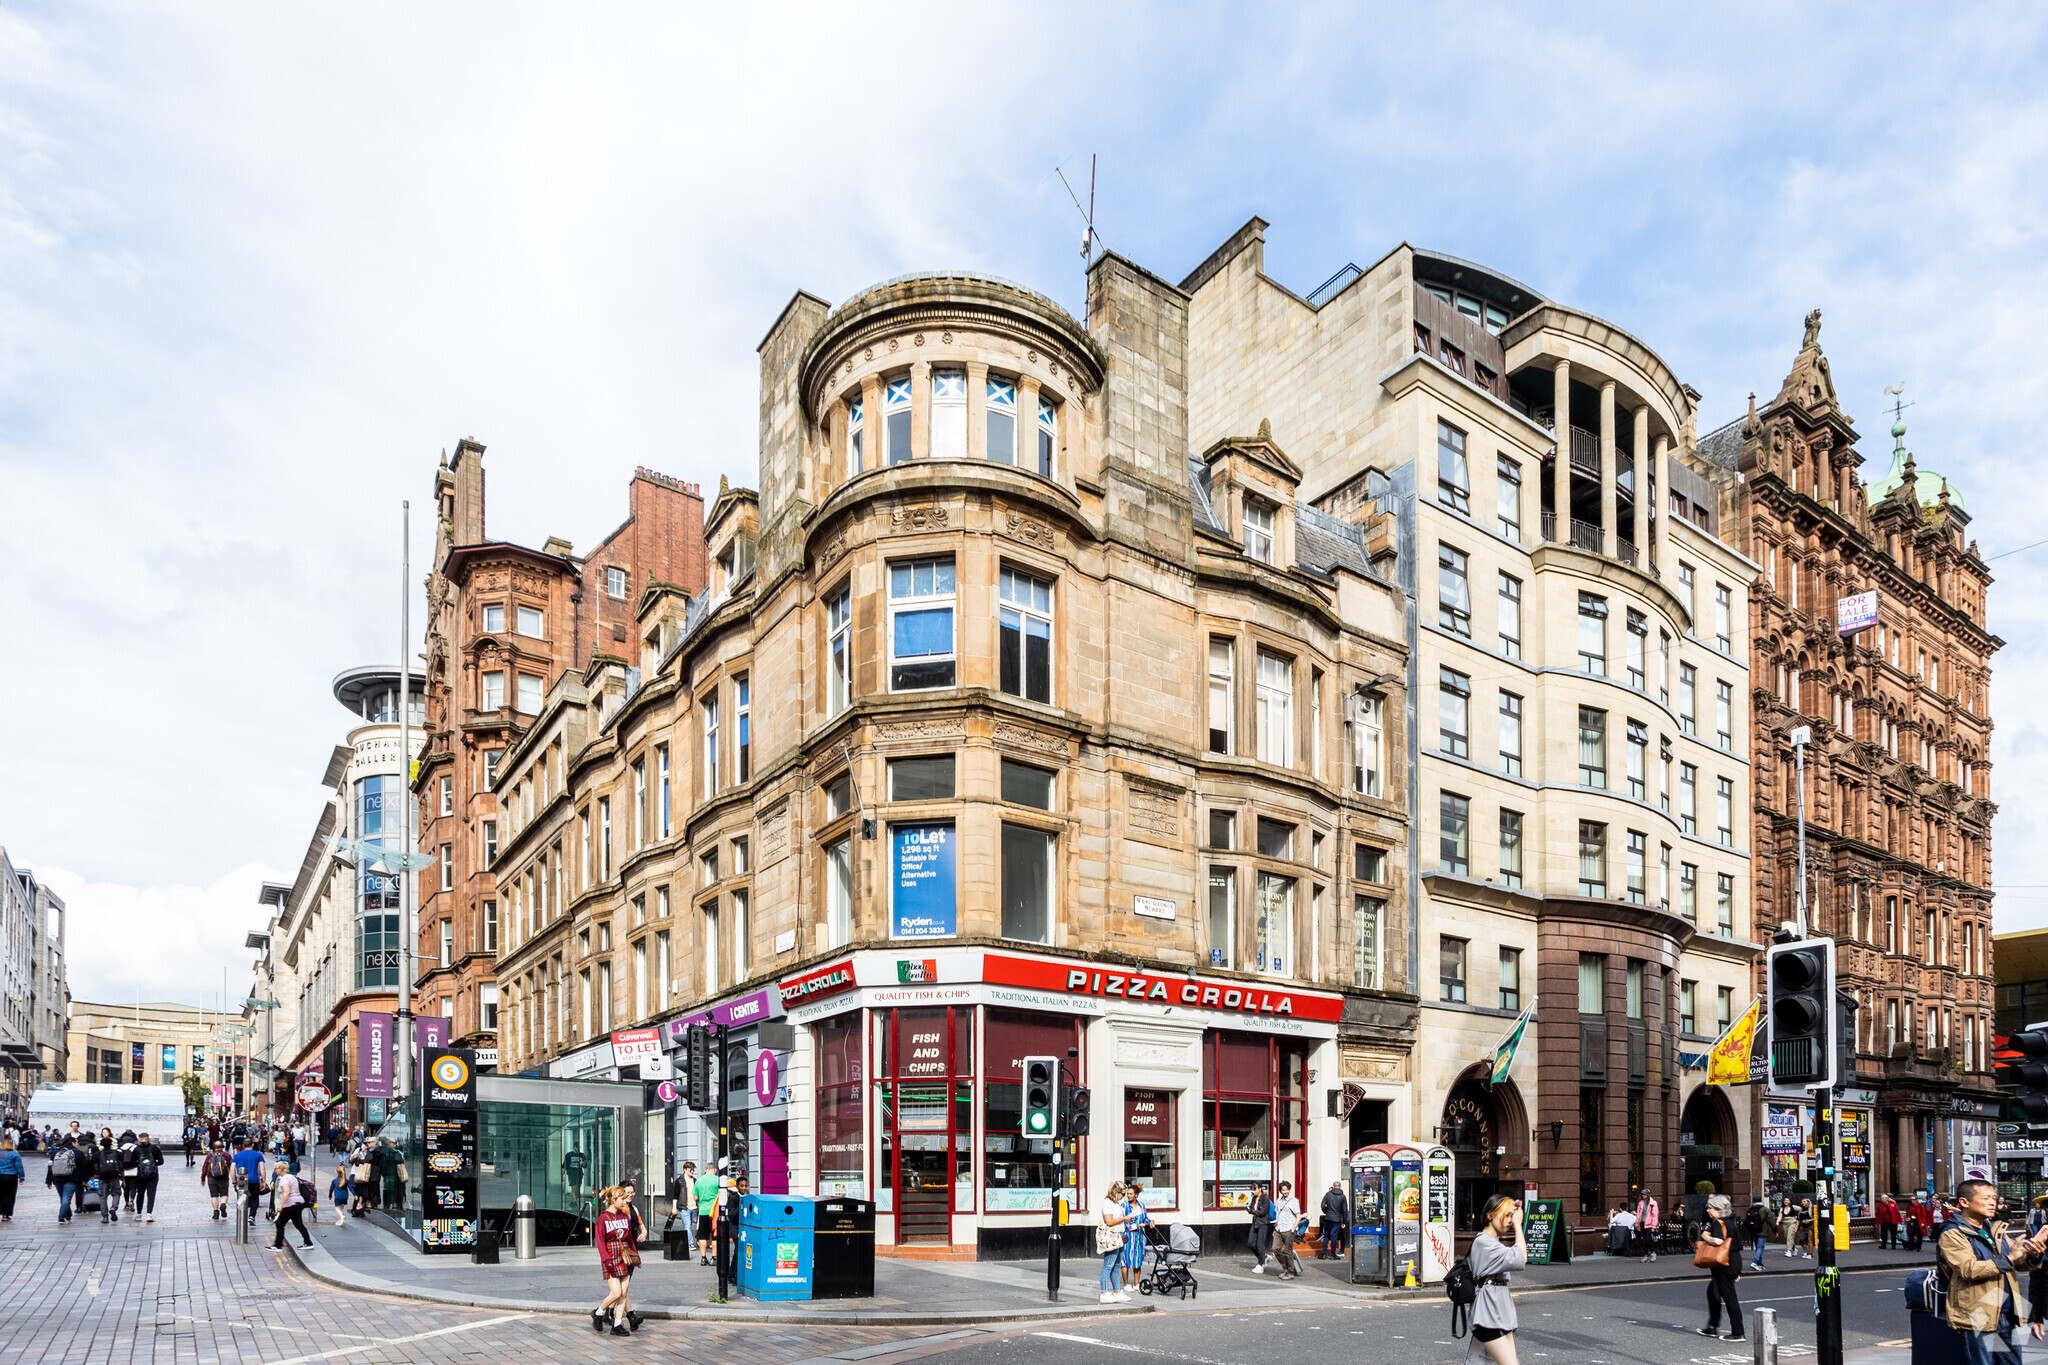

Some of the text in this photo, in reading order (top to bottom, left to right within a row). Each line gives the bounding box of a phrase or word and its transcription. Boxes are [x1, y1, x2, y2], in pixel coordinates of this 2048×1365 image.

[1840, 596, 1866, 608] FOR
[1838, 604, 1868, 618] SALE
[354, 740, 424, 754] BUCHANN
[901, 845, 921, 854] 1,298
[933, 844, 940, 852] ft
[902, 854, 926, 862] Suitable
[901, 862, 923, 871] Office/
[901, 871, 936, 879] Alternative
[1144, 905, 1165, 914] STREET
[1152, 901, 1174, 909] GEORGE
[929, 926, 945, 934] 3838
[900, 962, 929, 971] Pizza
[904, 970, 933, 979] Crolla
[780, 969, 853, 1000] PIZZA CROLLA
[874, 992, 912, 1001] QUALITY
[915, 991, 933, 999] FISH
[945, 990, 970, 998] CHIPS
[1066, 970, 1293, 1013] PIZZA CROLLA
[991, 990, 1097, 1010] TRADITIONAL ITALIAN PIZZAS
[734, 1000, 760, 1019] CENTRE
[1244, 1018, 1267, 1028] QUALITY
[618, 1032, 653, 1041] Culverwell
[912, 1033, 940, 1043] FISH
[371, 1029, 382, 1075] CENTRE
[617, 1042, 658, 1054] TO LET
[913, 1048, 940, 1058] AND
[909, 1063, 945, 1072] CHIPS
[431, 1091, 469, 1102] Subway
[1135, 1091, 1155, 1099] FISH
[1135, 1102, 1155, 1112] AND
[1131, 1116, 1157, 1124] CHIPS
[1825, 1111, 1830, 1119] 4
[1449, 1098, 1490, 1174] O'CONNOR'S
[1763, 1128, 1800, 1137] TO LET
[822, 1144, 846, 1152] TRADITIONAL
[1996, 1139, 2048, 1148] een Stree
[1231, 1145, 1264, 1154] Authentic
[1708, 1161, 1724, 1170] HOT
[1430, 1173, 1447, 1185] cash
[436, 1190, 465, 1204] 125
[1396, 1242, 1417, 1252] McPlant
